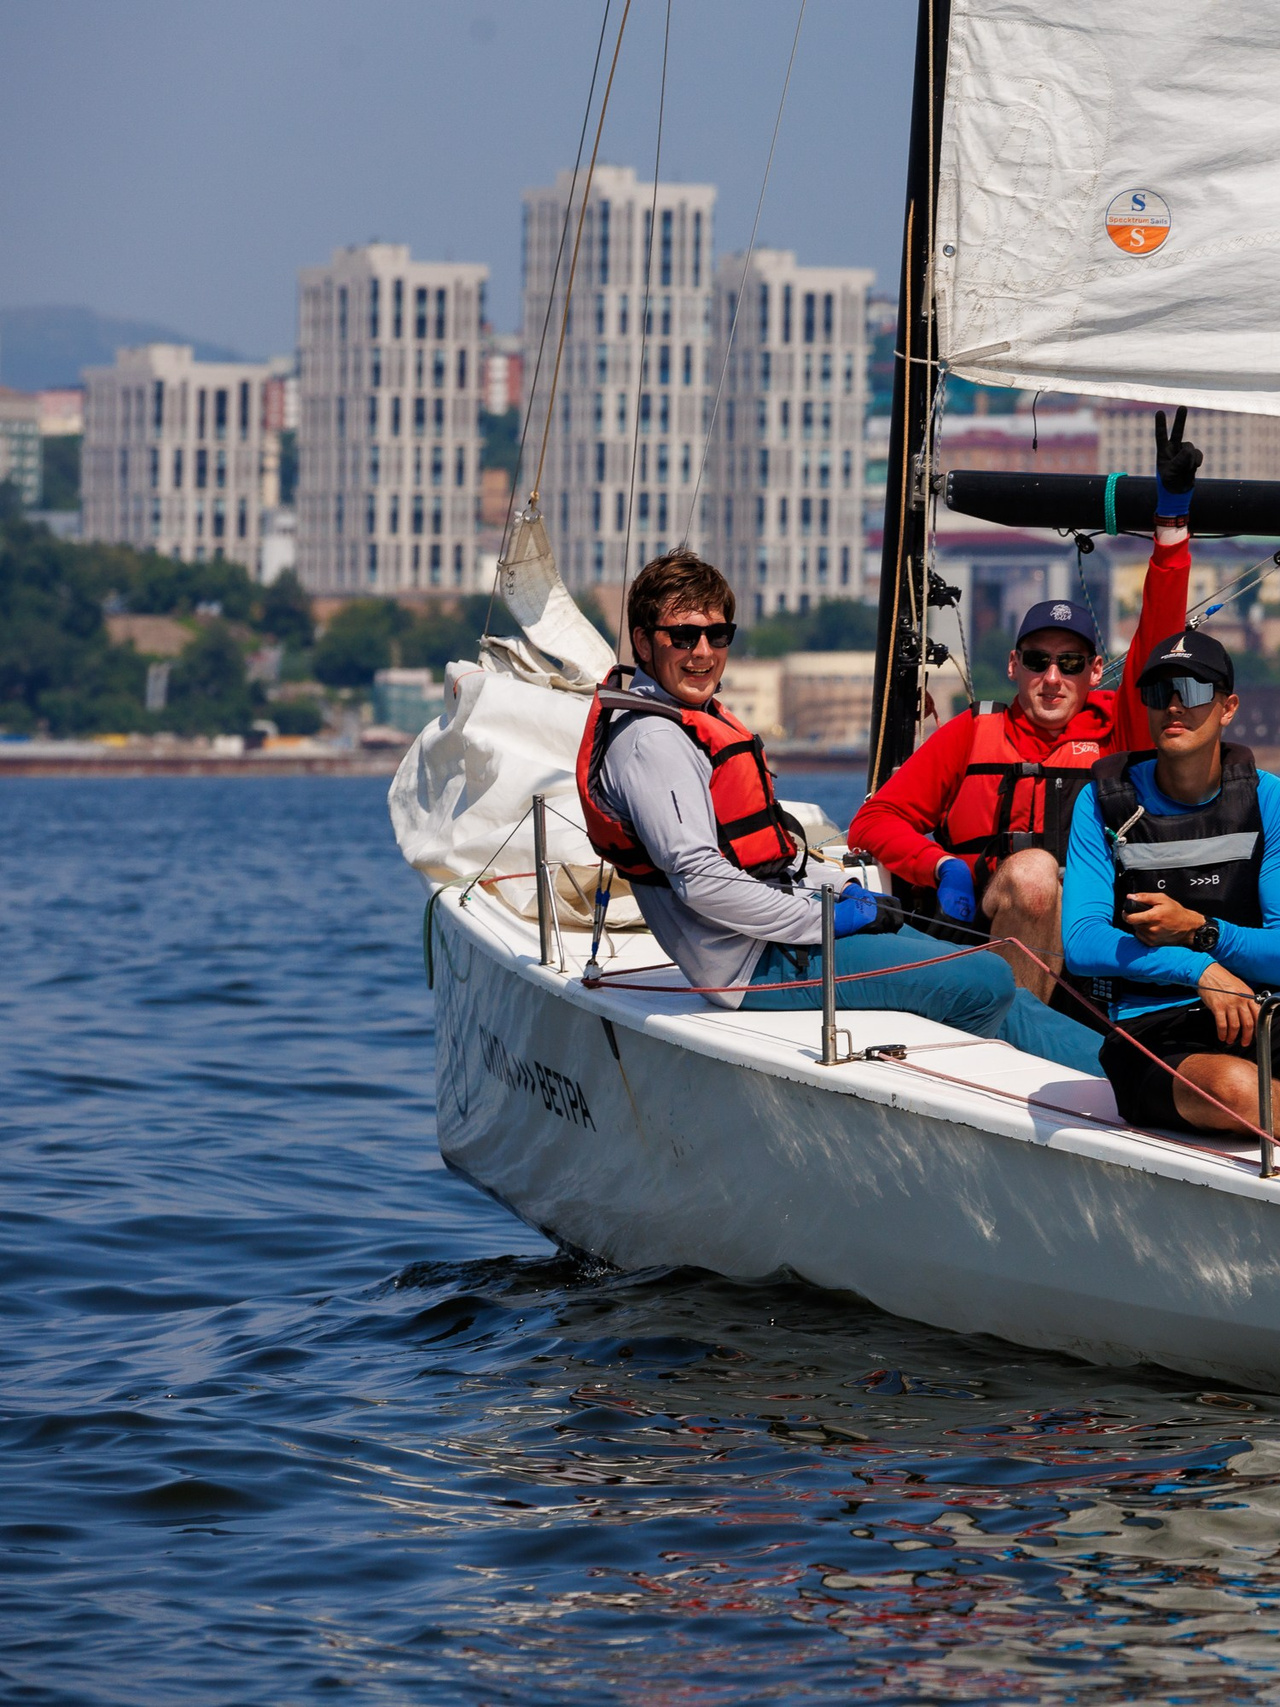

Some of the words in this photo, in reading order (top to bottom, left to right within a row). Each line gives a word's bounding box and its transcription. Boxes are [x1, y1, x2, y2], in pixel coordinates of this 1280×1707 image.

[1131, 193, 1146, 212] S
[1130, 228, 1145, 247] S
[534, 1060, 597, 1132] ВЕТРА
